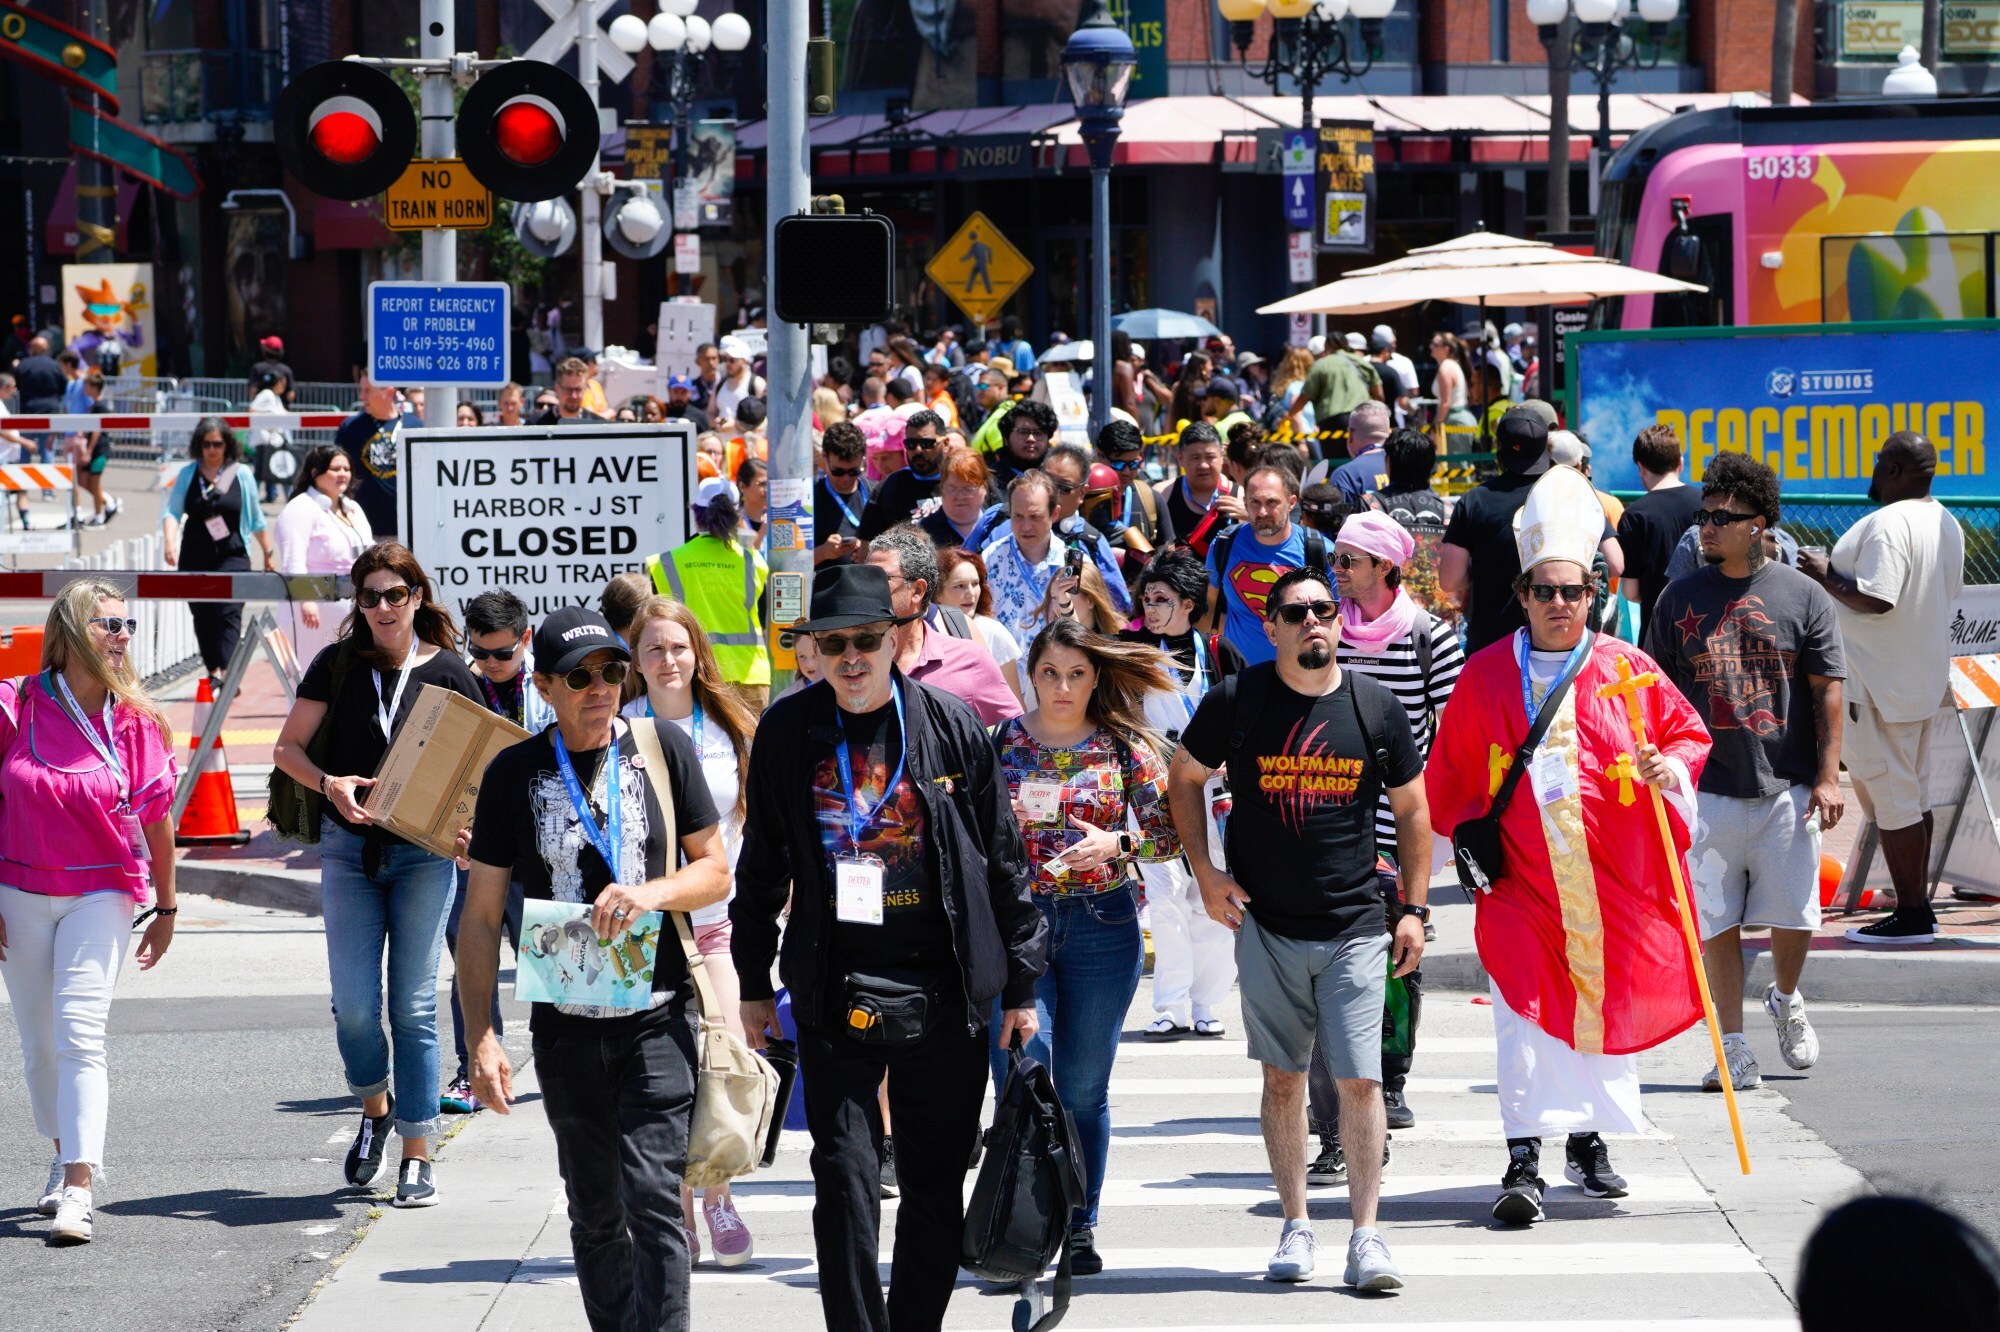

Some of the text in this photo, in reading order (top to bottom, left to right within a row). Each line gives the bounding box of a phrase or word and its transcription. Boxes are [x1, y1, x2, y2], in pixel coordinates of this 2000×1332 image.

[962, 144, 1022, 167] NOBU
[1319, 153, 1375, 173] POPULAR
[1747, 155, 1812, 180] 5033
[421, 170, 452, 189] NO
[1329, 172, 1365, 192] ARTS
[391, 199, 486, 219] TRAIN HORN
[381, 298, 496, 313] REPORT EMERGENCY
[402, 317, 476, 332] OR PROBLEM
[383, 336, 496, 351] TO 1-619-595-4960
[377, 355, 501, 370] CROSSING 026 878 F
[1800, 373, 1873, 390] STUDIOS
[436, 455, 659, 487] N/B 5TH AVE
[453, 497, 566, 518] HARBOR
[589, 496, 601, 515] J
[611, 495, 643, 515] ST
[460, 525, 638, 558] CLOSED
[435, 563, 647, 586] TO THRU TRAFFI
[561, 625, 609, 642] WRITER
[1951, 619, 2000, 645] ACME
[1257, 755, 1365, 776] WOLFMAN'S
[1260, 774, 1361, 792] GOT NARDS
[1028, 789, 1052, 799] DEXTER
[847, 875, 872, 887] DEXTER
